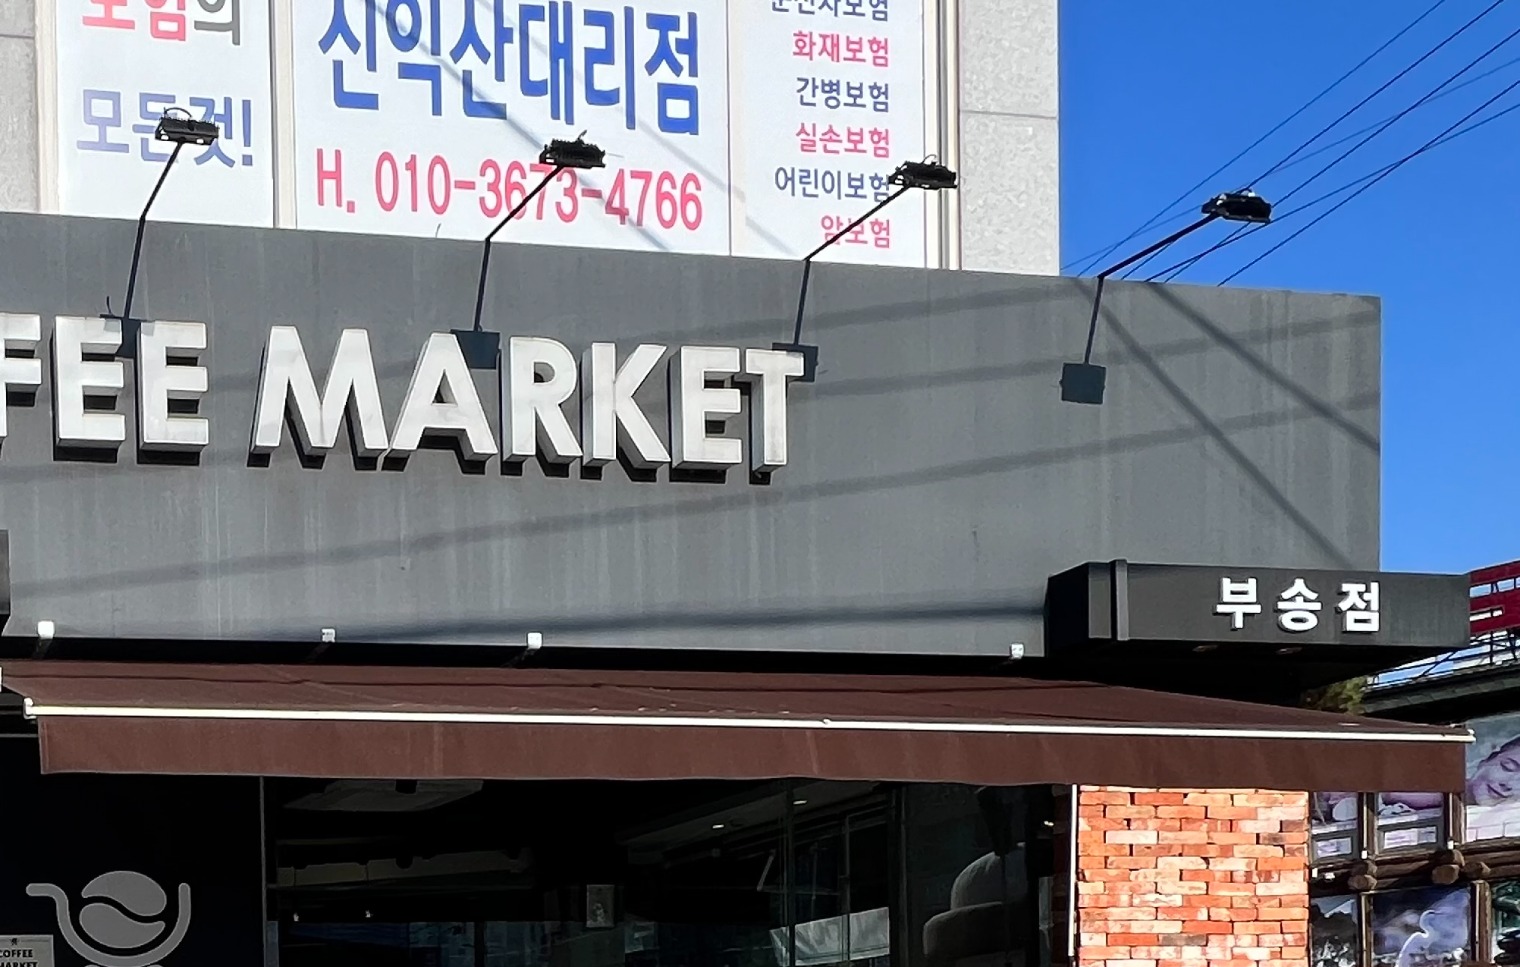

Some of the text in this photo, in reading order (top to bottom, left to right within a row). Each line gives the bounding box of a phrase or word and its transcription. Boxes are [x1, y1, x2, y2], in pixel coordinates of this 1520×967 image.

[318, 0, 700, 135] 신익산대리점
[793, 30, 889, 67] 화재보험
[796, 77, 890, 113] 간병보험
[796, 122, 890, 158] 실손보험
[316, 148, 703, 230] H. 010-3673-4766
[774, 166, 890, 203] 어린이보험
[250, 325, 805, 472] MARKET
[1215, 577, 1380, 632] 부송점
